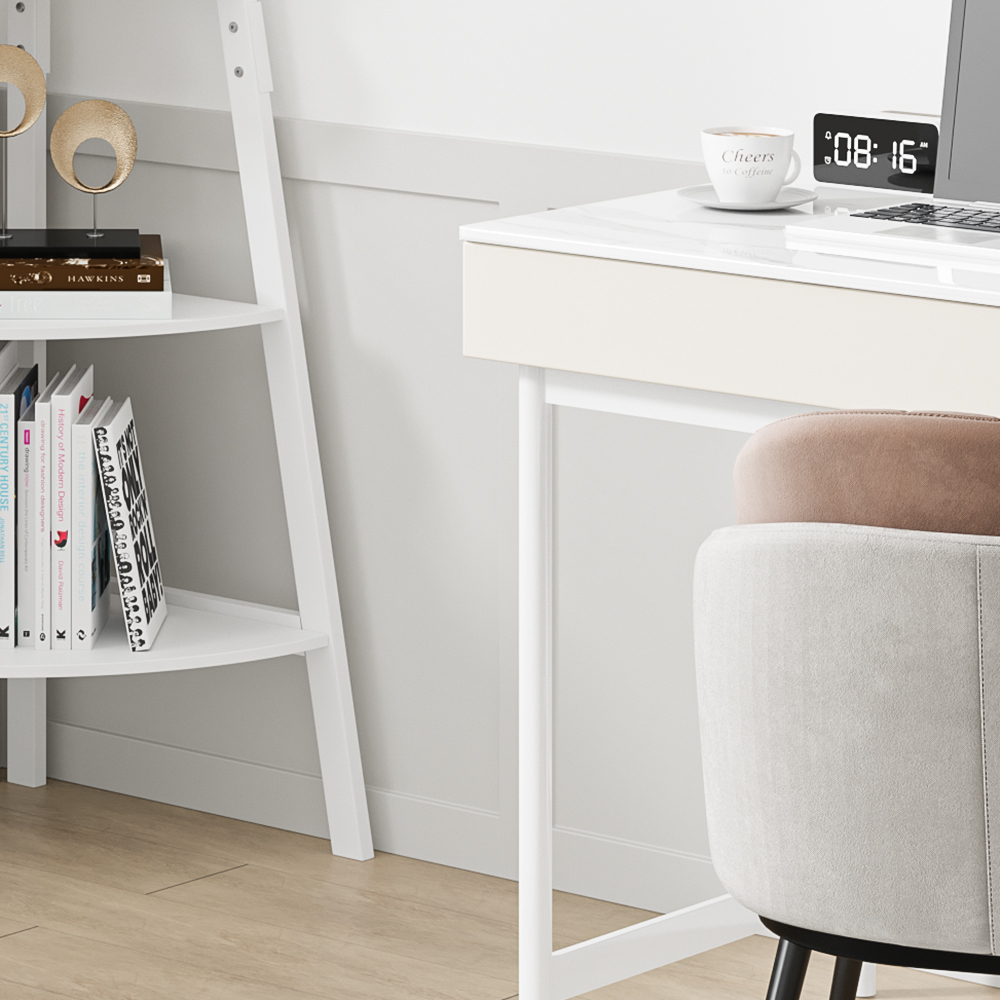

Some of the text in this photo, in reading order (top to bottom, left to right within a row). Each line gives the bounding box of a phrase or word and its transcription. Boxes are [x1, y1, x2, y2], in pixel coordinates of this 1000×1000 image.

[721, 148, 775, 164] Cheers
[919, 141, 929, 149] AM
[722, 166, 774, 178] to Coffeine
[67, 275, 125, 283] HAWKINS
[38, 420, 47, 452] drawing
[123, 418, 137, 457] NOT
[0, 403, 9, 511] 21ST CENTURY HOUSE
[23, 447, 31, 473] drawing
[56, 408, 66, 522] History of Modern Design
[78, 451, 87, 472] the
[78, 474, 87, 518] interior
[121, 445, 143, 512] ONLY
[38, 495, 47, 533] designers
[128, 497, 144, 541] ROCK
[75, 520, 87, 561] design
[133, 521, 158, 589] ROLL
[141, 561, 163, 625] BABY!
